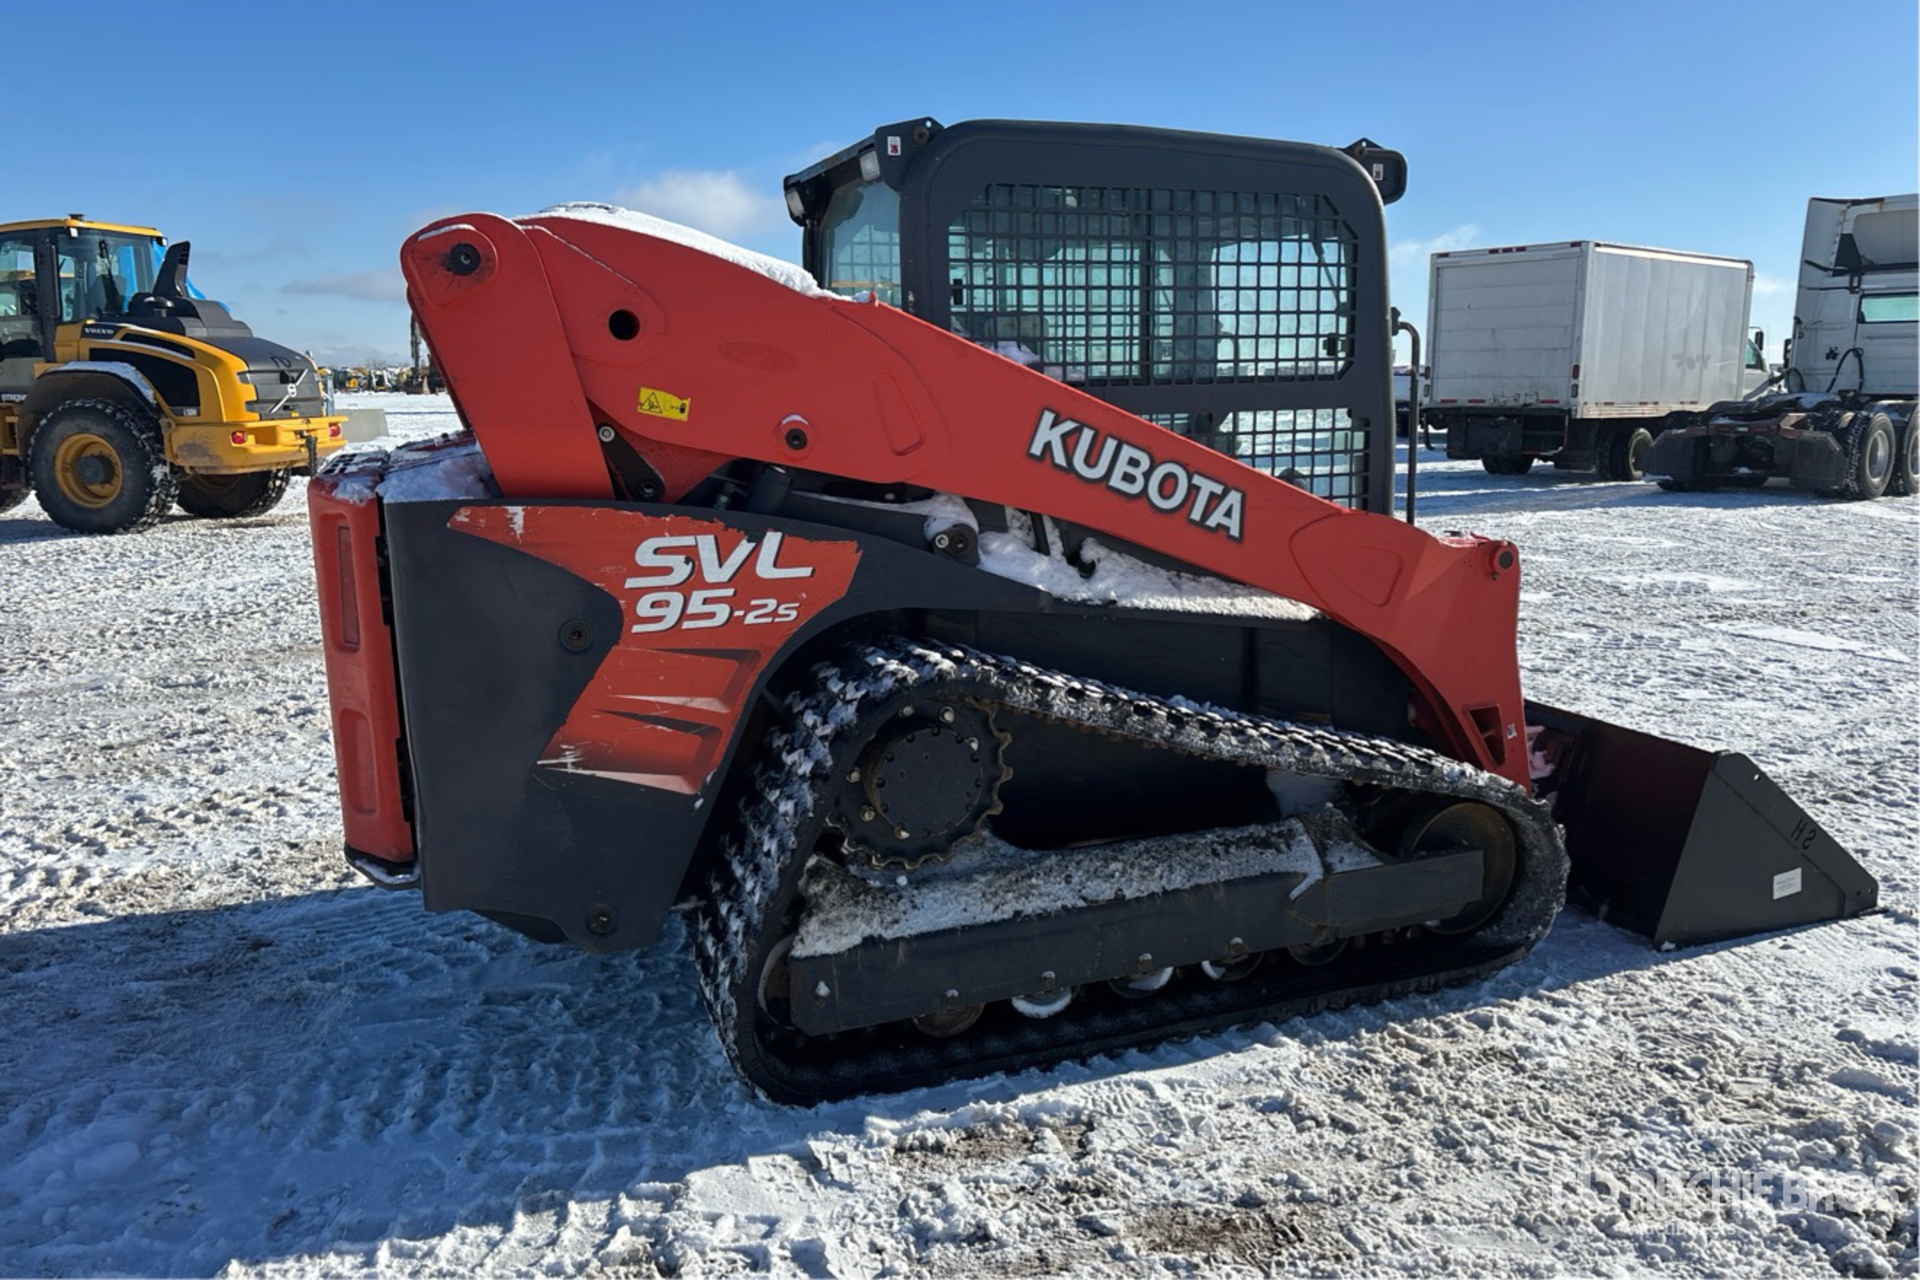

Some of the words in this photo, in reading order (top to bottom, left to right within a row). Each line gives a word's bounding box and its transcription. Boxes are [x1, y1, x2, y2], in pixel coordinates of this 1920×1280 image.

[84, 327, 114, 335] VOLVO
[1028, 408, 1245, 541] KUBOTA
[624, 531, 815, 589] SVL
